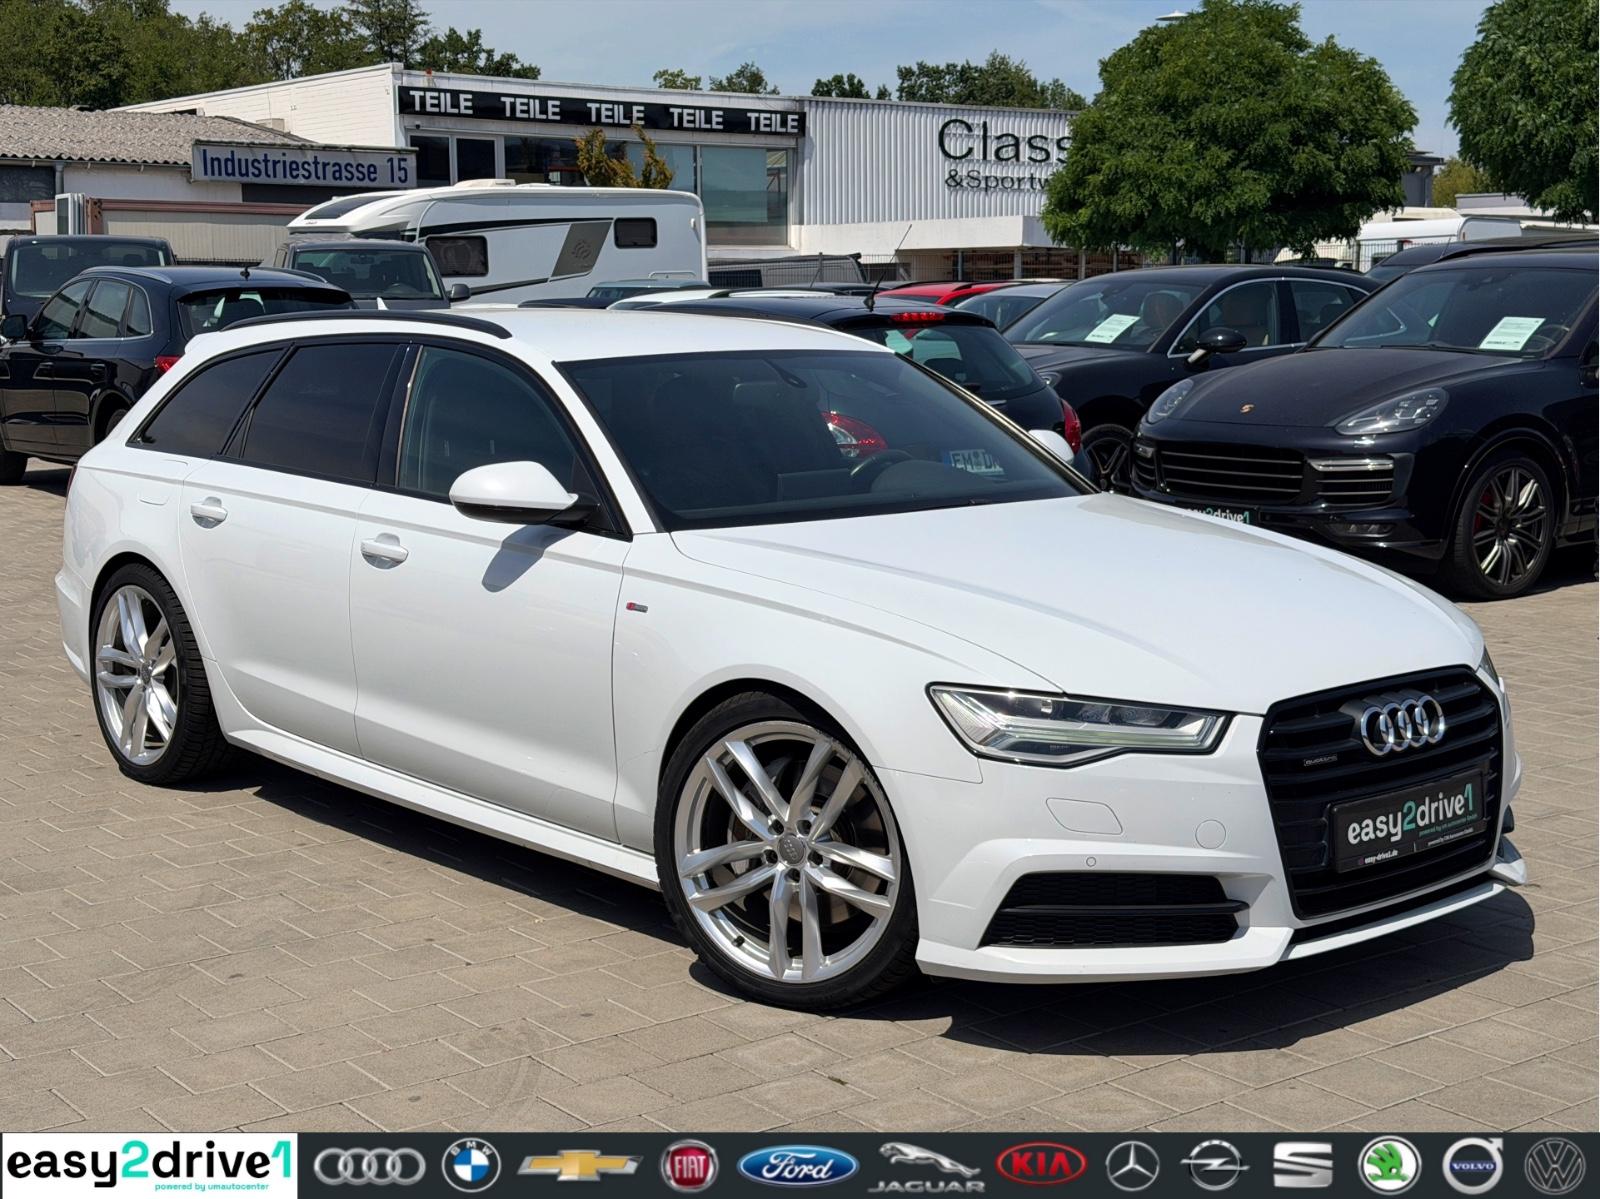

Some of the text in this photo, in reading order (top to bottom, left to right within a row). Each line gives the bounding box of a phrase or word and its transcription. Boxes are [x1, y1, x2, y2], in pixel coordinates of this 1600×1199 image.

[410, 91, 799, 133] TEILE TEILE TEILE TEILE TEILE
[203, 149, 408, 183] Industriestrasse 15
[1348, 783, 1473, 844] easy2drive1
